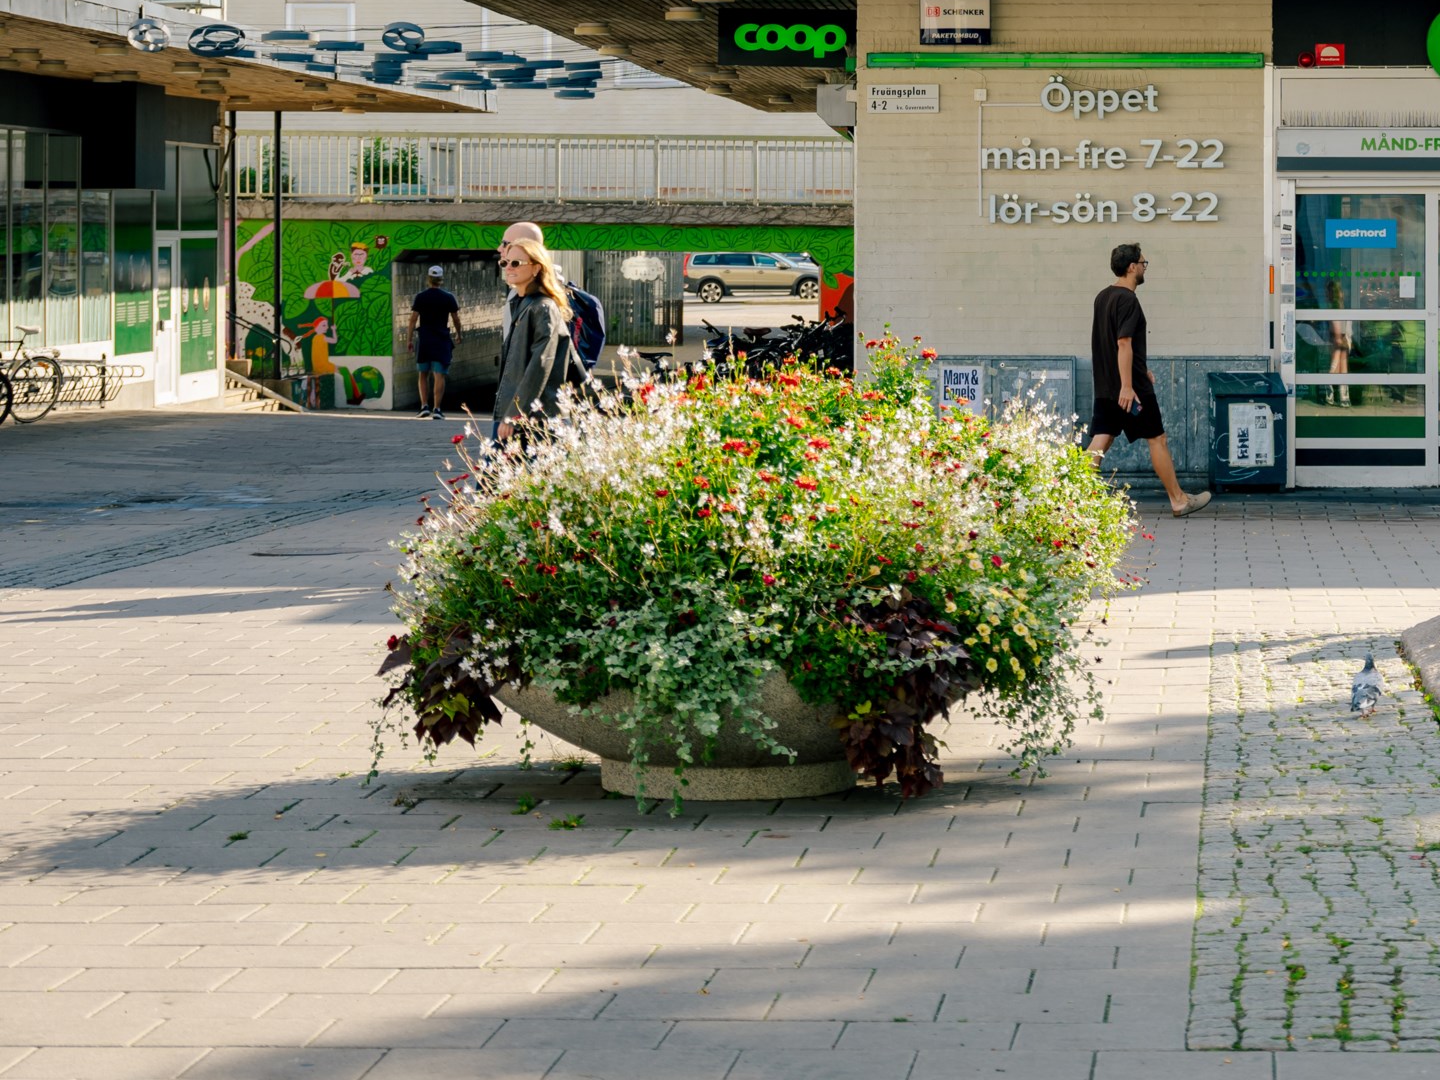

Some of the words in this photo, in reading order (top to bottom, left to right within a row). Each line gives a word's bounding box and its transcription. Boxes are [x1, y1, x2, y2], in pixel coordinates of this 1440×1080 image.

[943, 8, 985, 16] SCHENKER
[734, 23, 848, 58] coop
[871, 86, 927, 98] Fruängsplan
[1040, 75, 1159, 119] Öppet
[871, 100, 888, 110] 4-2
[981, 137, 1127, 170] mån-fre
[1140, 138, 1225, 169] 7-22
[989, 193, 1118, 224] lör-sön
[1131, 192, 1219, 223] 8-22
[1335, 228, 1387, 238] postnord
[943, 369, 970, 385] Marx
[971, 369, 979, 385] &
[943, 385, 976, 401] Engels
